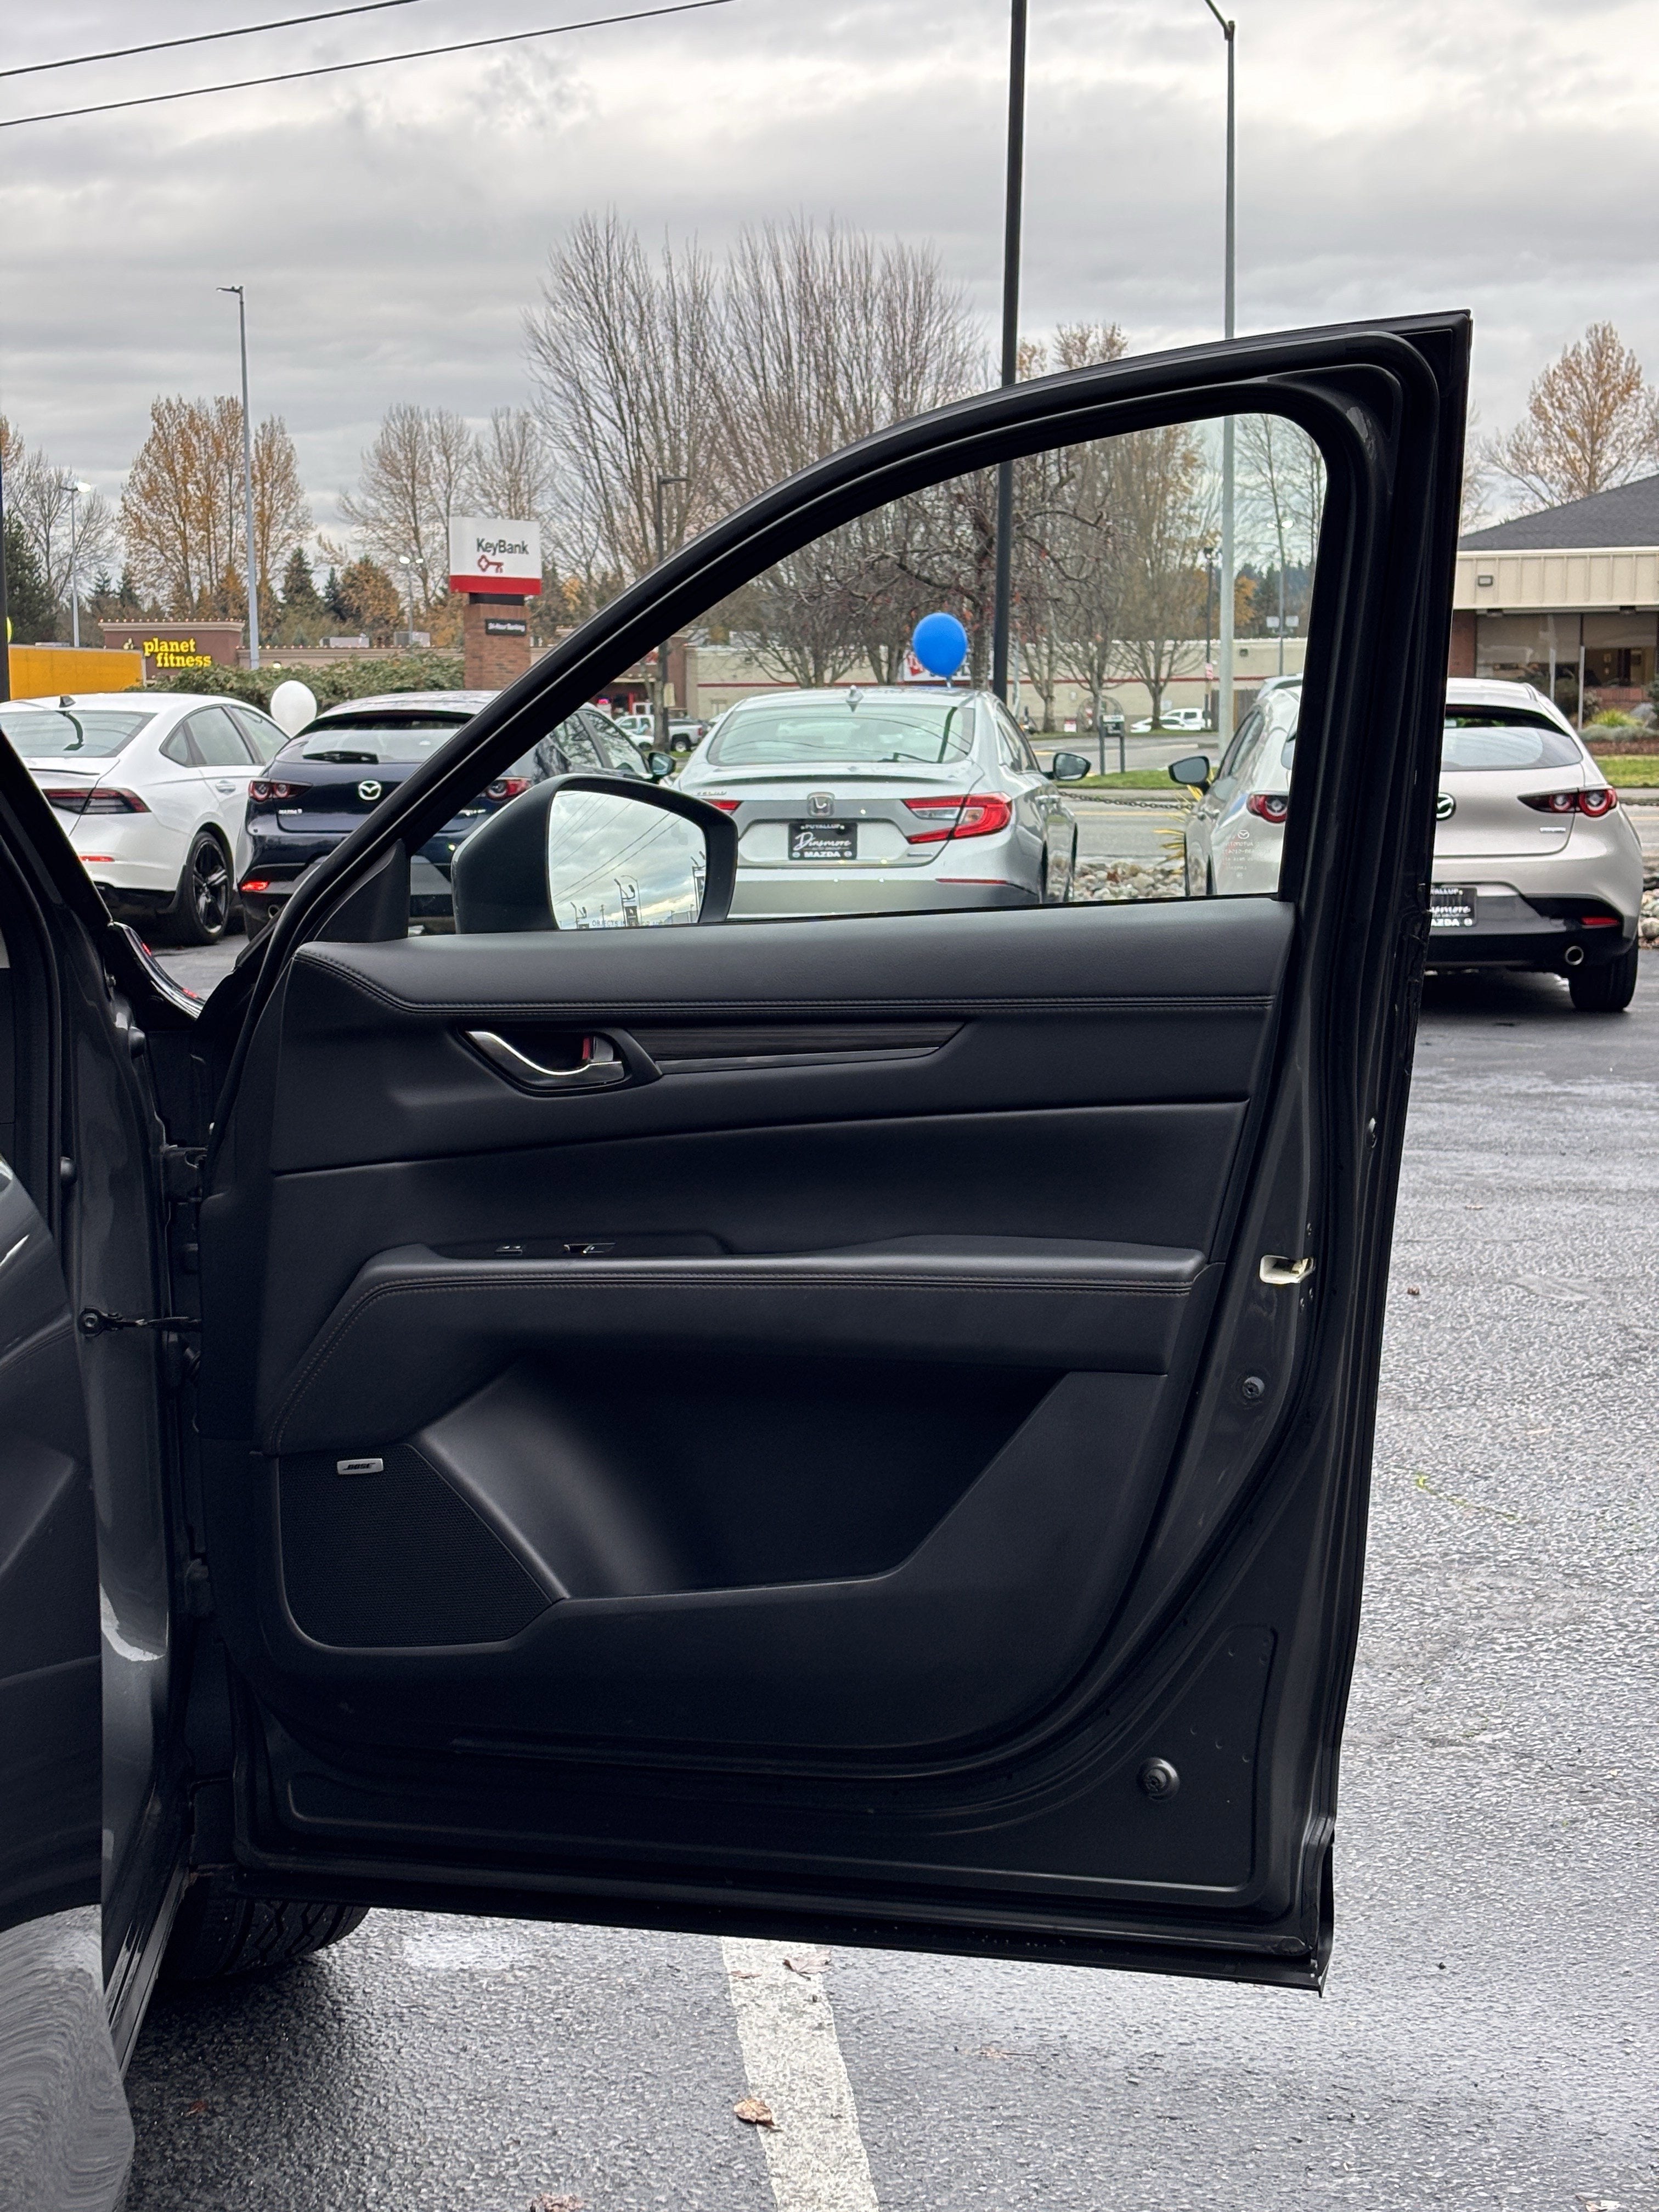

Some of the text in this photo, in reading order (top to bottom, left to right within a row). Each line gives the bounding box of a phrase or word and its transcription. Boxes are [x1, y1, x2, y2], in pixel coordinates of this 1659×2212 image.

[476, 538, 529, 556] KeyBank
[143, 637, 196, 657] planet
[156, 652, 212, 668] fitness
[1430, 918, 1460, 927] AZDA
